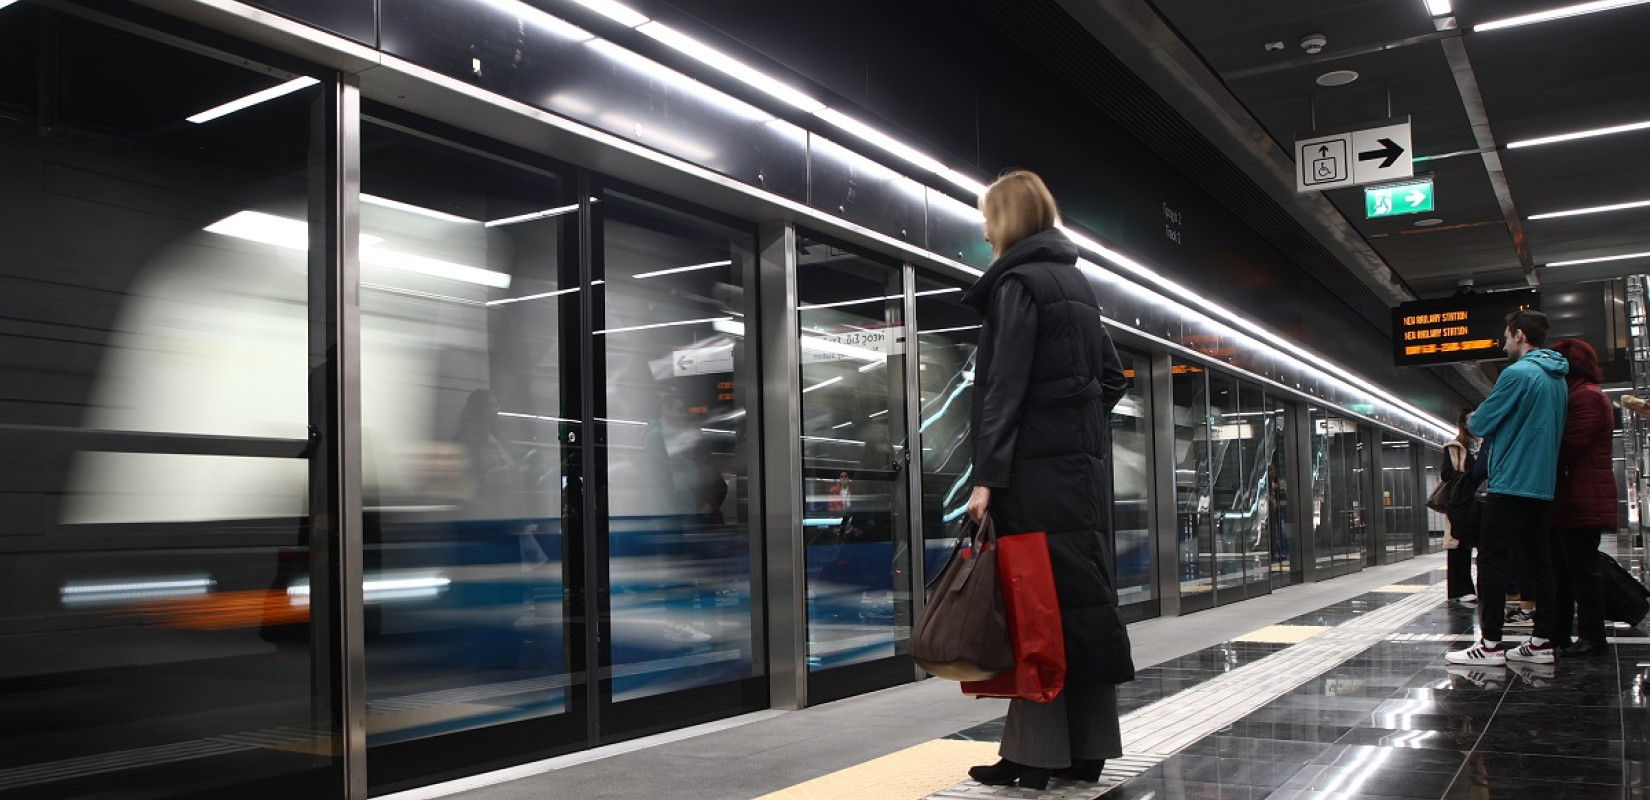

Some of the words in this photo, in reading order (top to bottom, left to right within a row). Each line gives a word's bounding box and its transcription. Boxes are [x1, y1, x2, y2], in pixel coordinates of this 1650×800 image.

[1403, 316, 1416, 326] NEW
[1416, 314, 1441, 325] RAILWAY
[1442, 311, 1468, 322] STATION
[1404, 331, 1416, 341] NEW
[1417, 328, 1442, 340] RAILWAY
[1442, 326, 1468, 337] STATION
